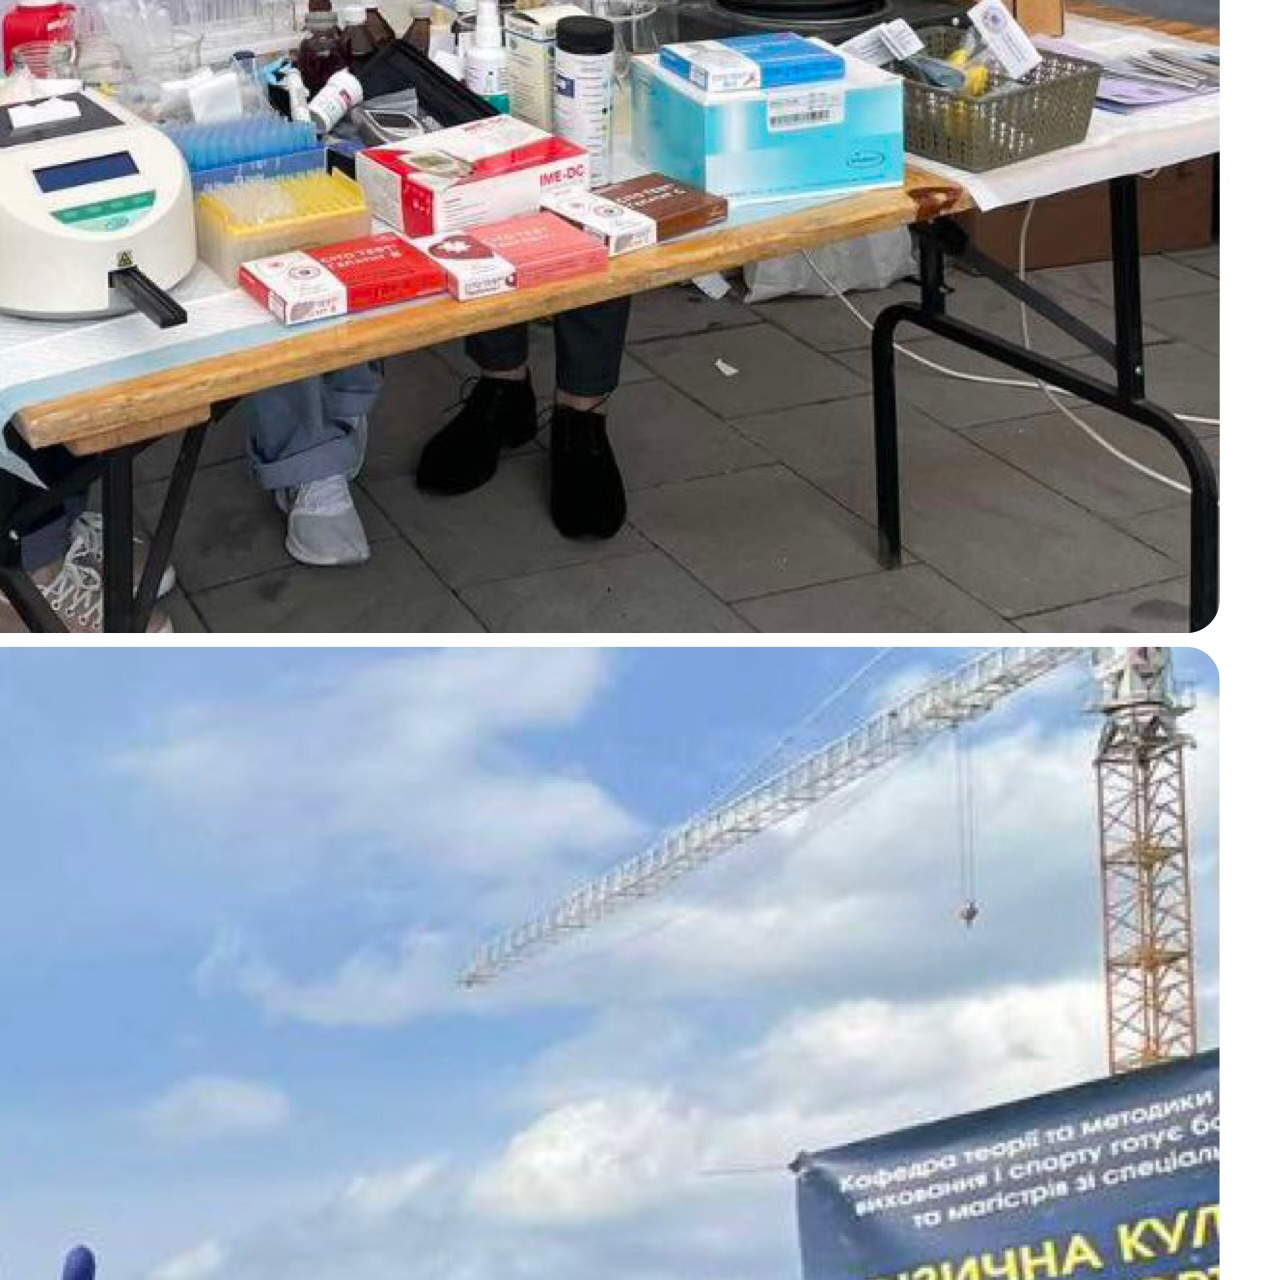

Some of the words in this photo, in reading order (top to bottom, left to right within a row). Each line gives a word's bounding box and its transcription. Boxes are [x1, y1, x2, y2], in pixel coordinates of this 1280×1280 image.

[540, 164, 585, 186] IME-DC
[840, 1154, 957, 1193] Кафедра
[963, 1128, 1039, 1164] теорії
[1081, 1090, 1213, 1136] методики
[856, 1173, 988, 1216] виховання
[1010, 1145, 1101, 1182] спорту
[1110, 1125, 1183, 1157] готує
[914, 1212, 940, 1229] та
[948, 1179, 1069, 1221] магістрів
[1075, 1171, 1096, 1191] зі
